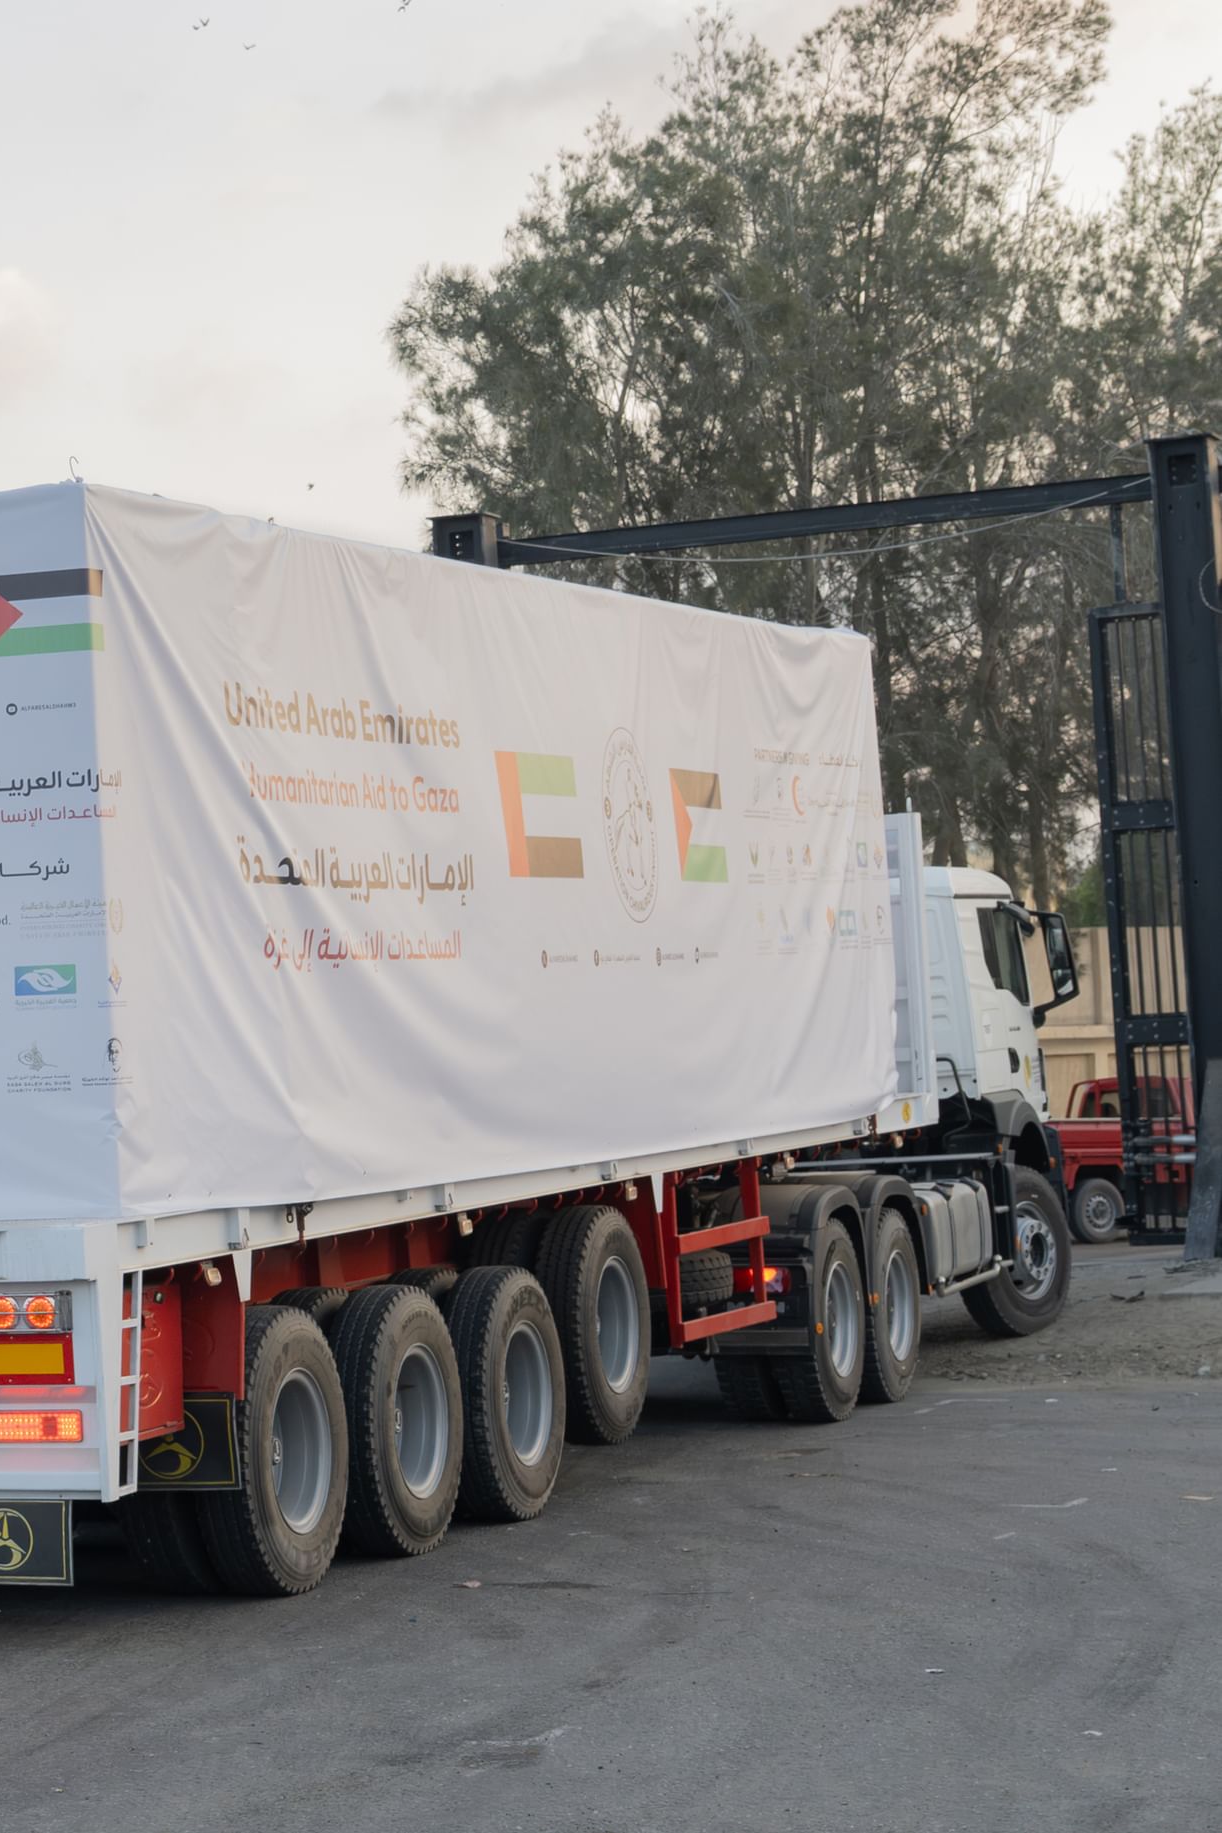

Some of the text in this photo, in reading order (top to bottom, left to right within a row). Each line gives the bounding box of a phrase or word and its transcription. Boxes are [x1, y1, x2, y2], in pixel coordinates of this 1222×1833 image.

[223, 680, 461, 749] United Arab Emirates
[362, 771, 387, 811] Aid
[389, 777, 409, 811] to
[411, 775, 460, 814] Gaza
[329, 846, 395, 904] العربية
[395, 852, 475, 906] الإمارات
[387, 929, 462, 961] المساعدات
